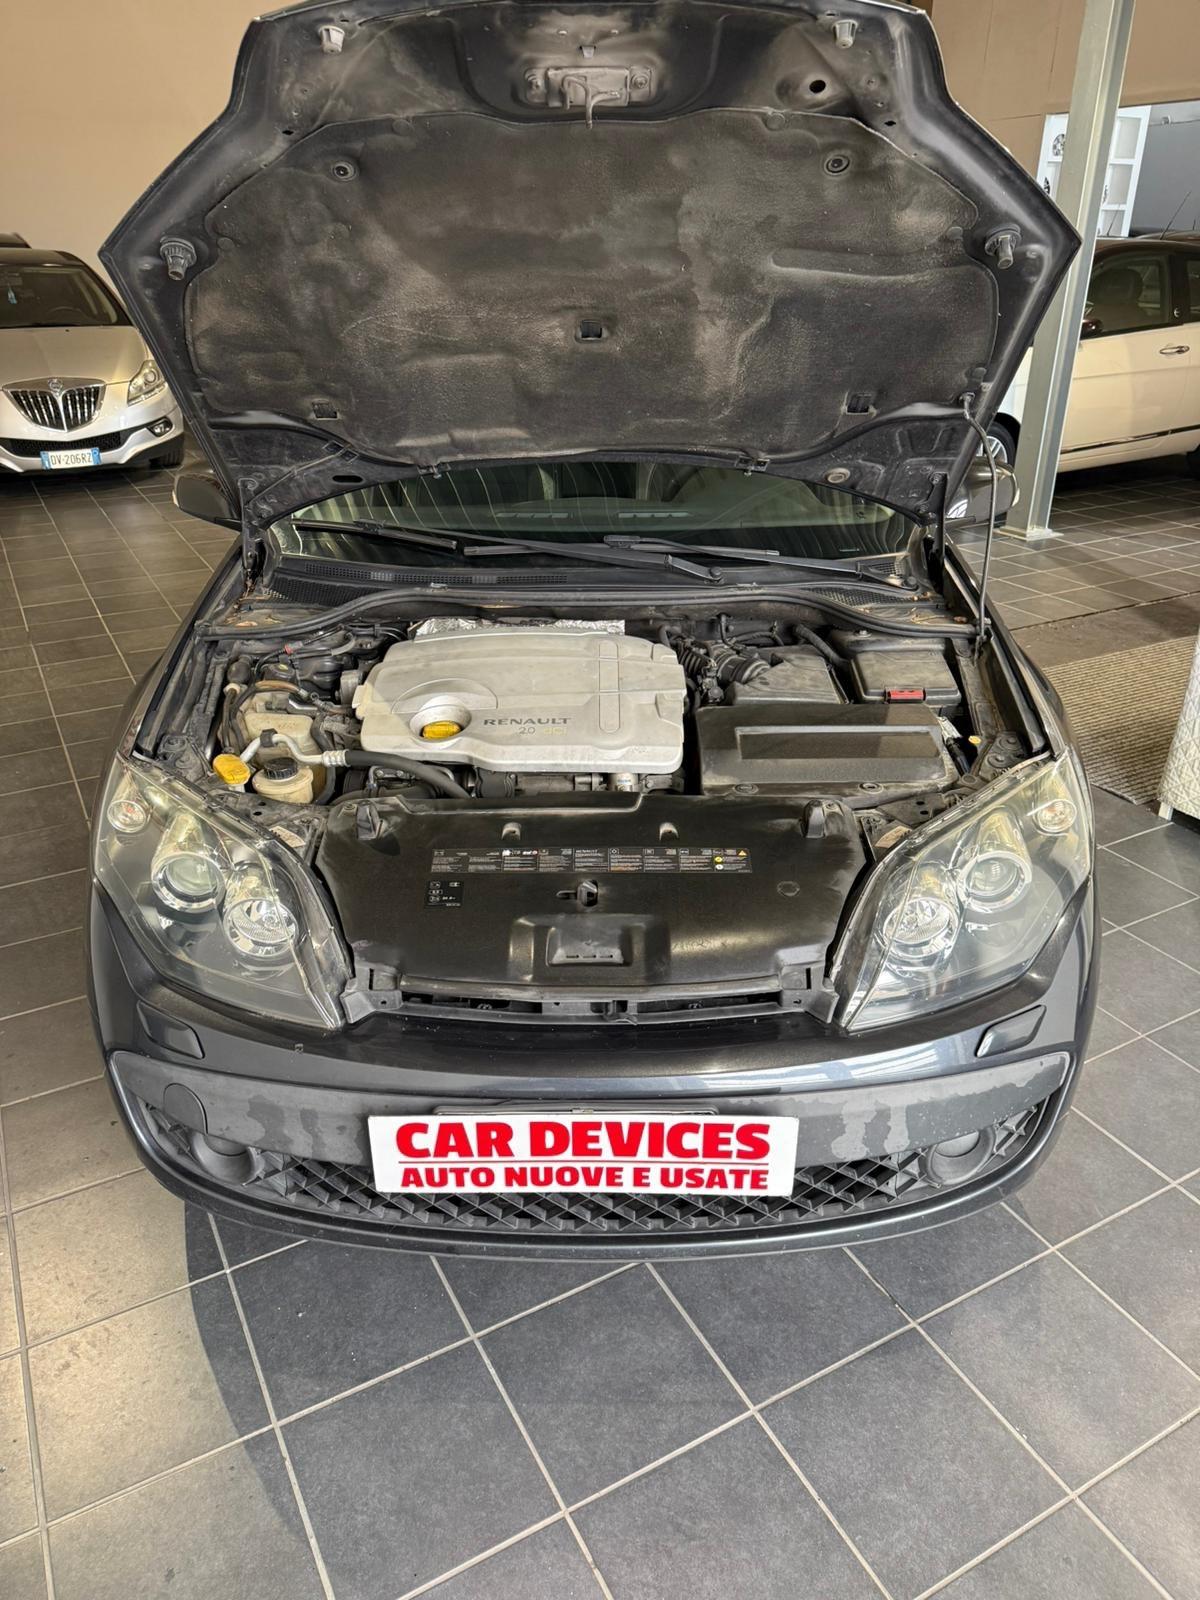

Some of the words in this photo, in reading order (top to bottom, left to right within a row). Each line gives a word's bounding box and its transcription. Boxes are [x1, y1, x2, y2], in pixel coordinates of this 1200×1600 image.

[483, 717, 571, 726] RENAULT
[396, 1121, 514, 1158] CAR
[529, 1122, 770, 1160] DEVICES
[401, 1167, 495, 1188] AUTO
[505, 1166, 623, 1188] NUOVE
[633, 1166, 650, 1188] E
[660, 1167, 768, 1190] USATE
